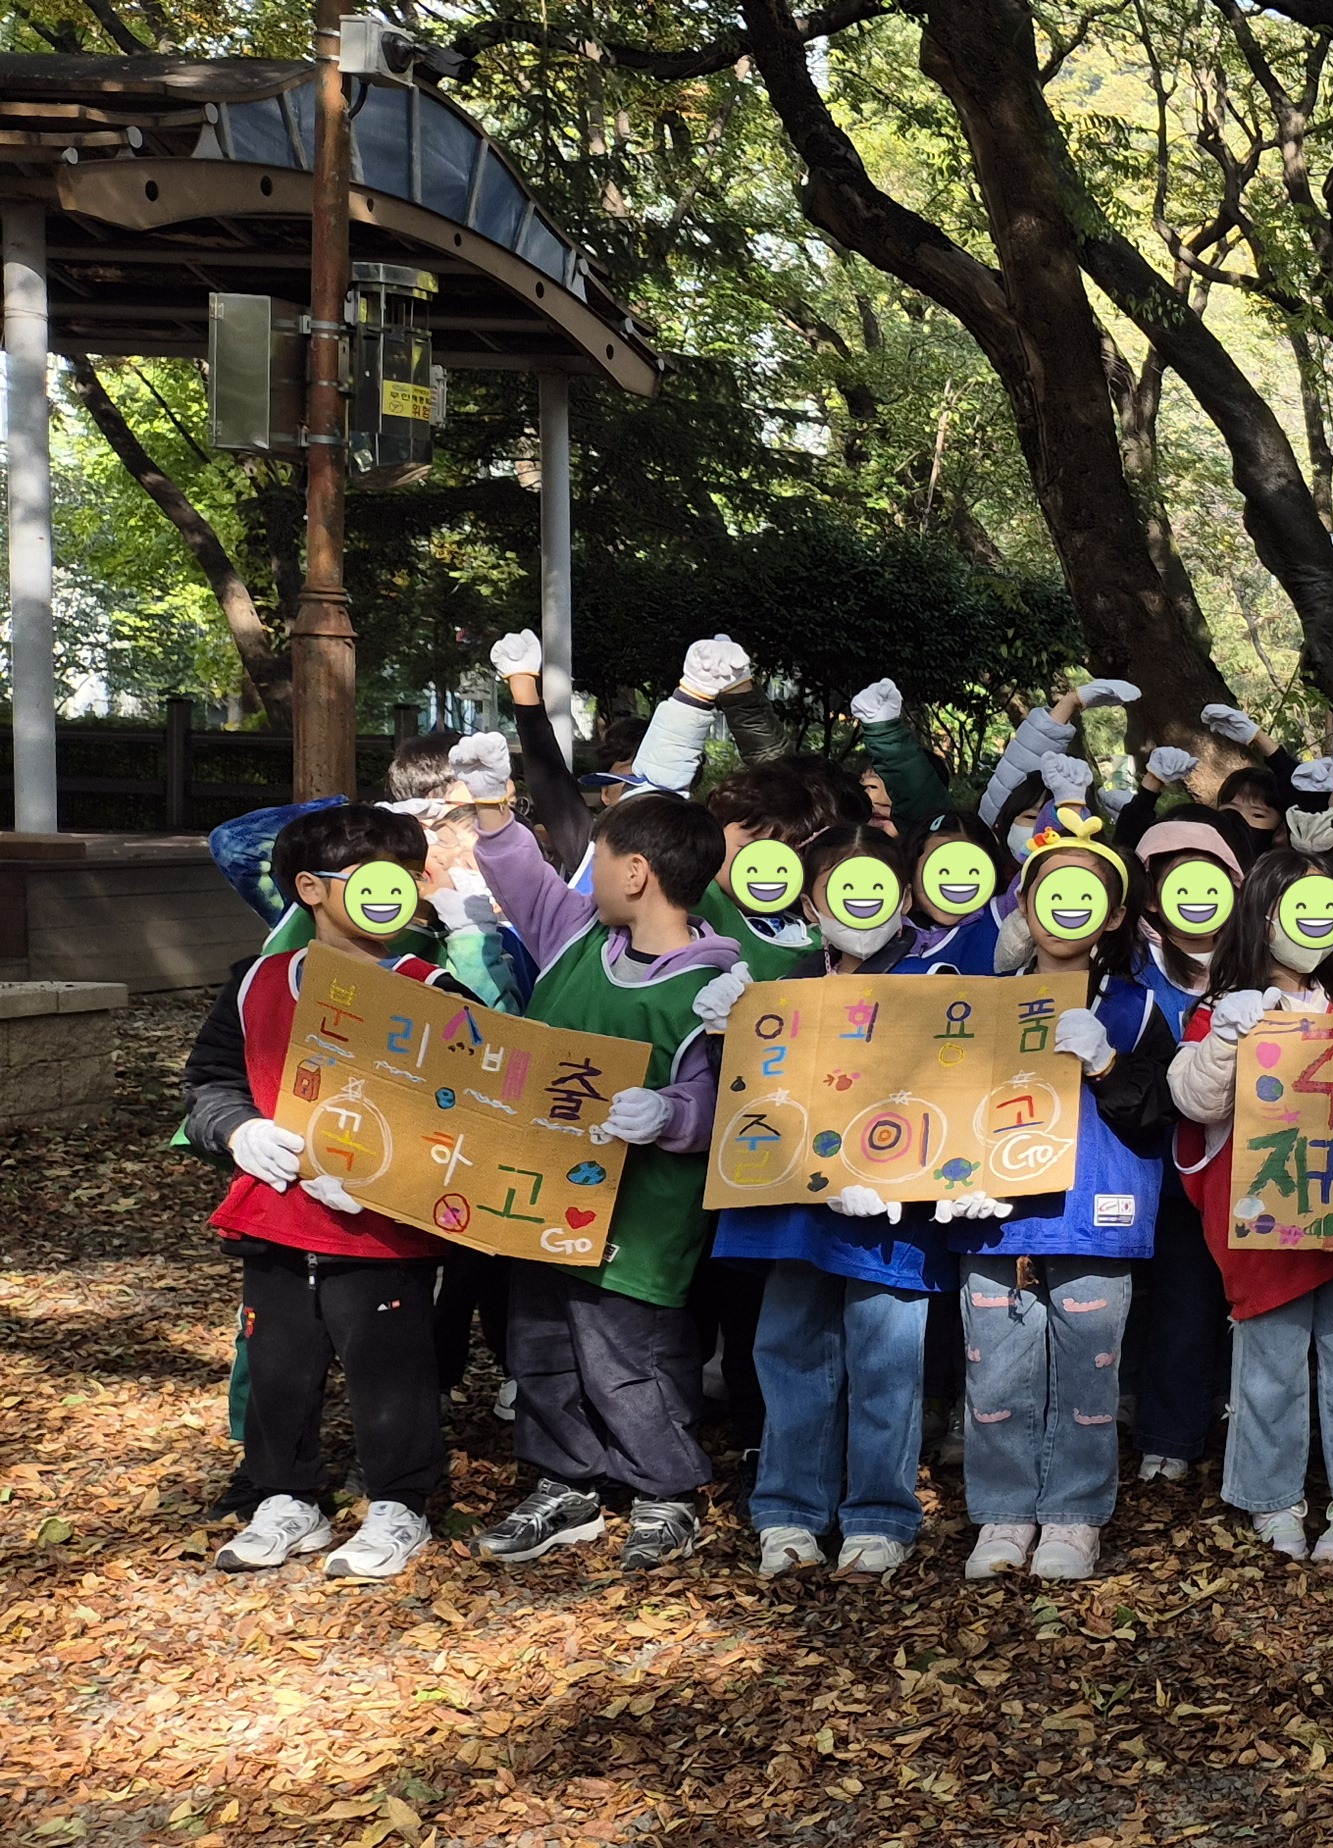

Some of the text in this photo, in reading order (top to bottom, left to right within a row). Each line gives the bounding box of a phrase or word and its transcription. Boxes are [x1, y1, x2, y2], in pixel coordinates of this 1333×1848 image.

[755, 999, 1055, 1076] 일회용품
[421, 1131, 545, 1223] 하고
[735, 1095, 1044, 1184] 줄이고
